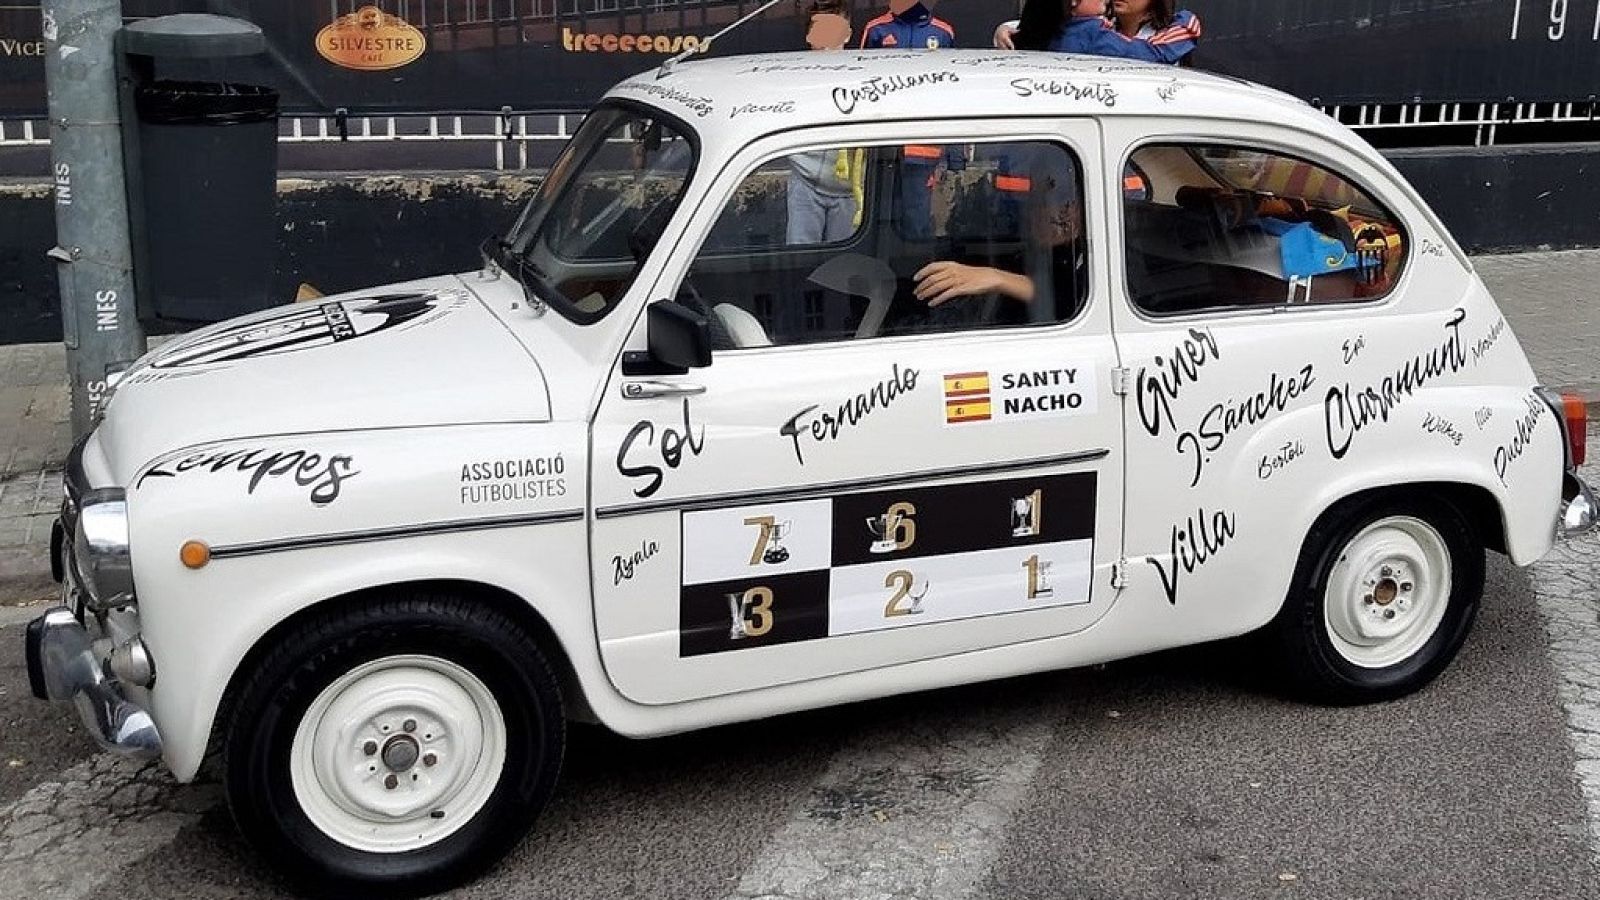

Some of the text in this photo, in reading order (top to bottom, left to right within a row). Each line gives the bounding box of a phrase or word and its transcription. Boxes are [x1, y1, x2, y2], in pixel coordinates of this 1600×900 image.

[329, 38, 414, 51] SILVESTRE
[729, 101, 795, 119] Vicente
[832, 71, 959, 115] Castellanos
[1010, 77, 1119, 107] Subirats
[1002, 369, 1077, 390] SANTY
[1136, 326, 1219, 437] Giner
[1324, 308, 1467, 459] Claramunt
[780, 363, 920, 466] Fernando
[1003, 393, 1082, 414] NACHO
[460, 452, 565, 482] ASSOCIACIÓ
[616, 397, 705, 498] Sol
[460, 478, 566, 504] FUTBOLISTES
[1027, 488, 1042, 535] 1
[743, 515, 775, 566] 7
[886, 502, 917, 551] 6
[1021, 554, 1039, 599] 1
[1146, 507, 1235, 606] Villa
[743, 586, 774, 637] 3
[884, 569, 918, 618] 2
